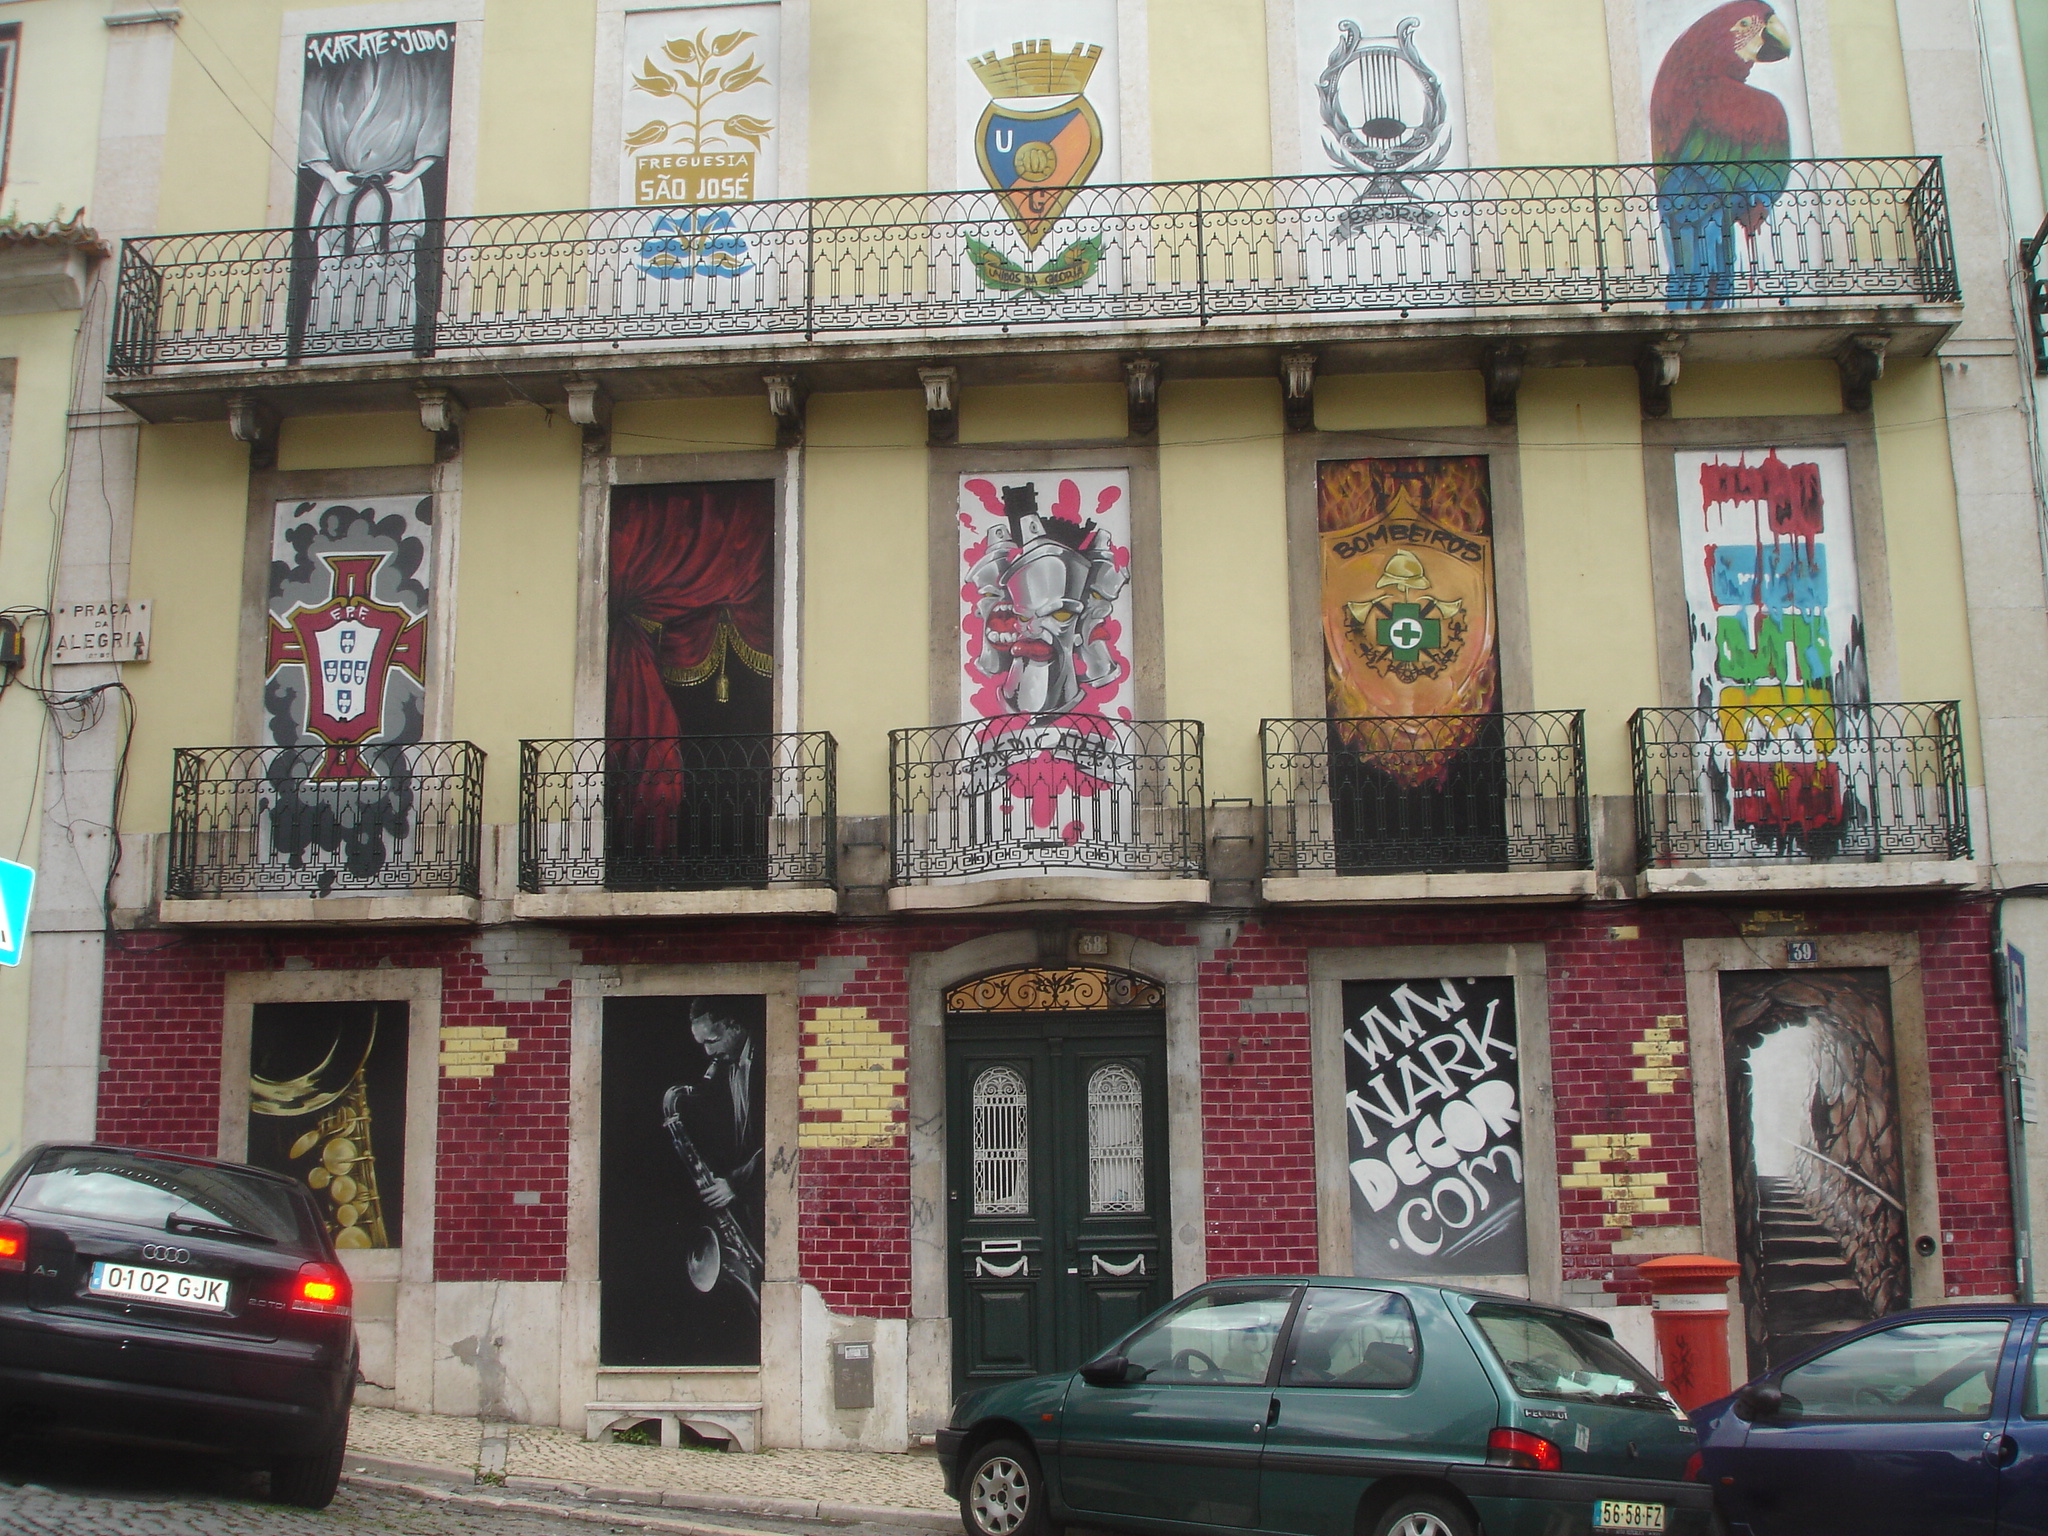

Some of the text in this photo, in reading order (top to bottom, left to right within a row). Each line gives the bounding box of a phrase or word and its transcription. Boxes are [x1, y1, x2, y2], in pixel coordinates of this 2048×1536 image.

[995, 129, 1013, 153] U
[638, 154, 748, 170] FREGUESIA
[640, 172, 749, 201] SÃO JOSÉ
[1332, 523, 1484, 563] BOMBEIROS
[94, 620, 109, 629] DA
[56, 631, 146, 651] ALEGRIA
[1792, 942, 1812, 961] 39
[1345, 998, 1518, 1149] NARK
[1348, 1079, 1521, 1213] DECOR
[1525, 1409, 1568, 1420] PEUOT
